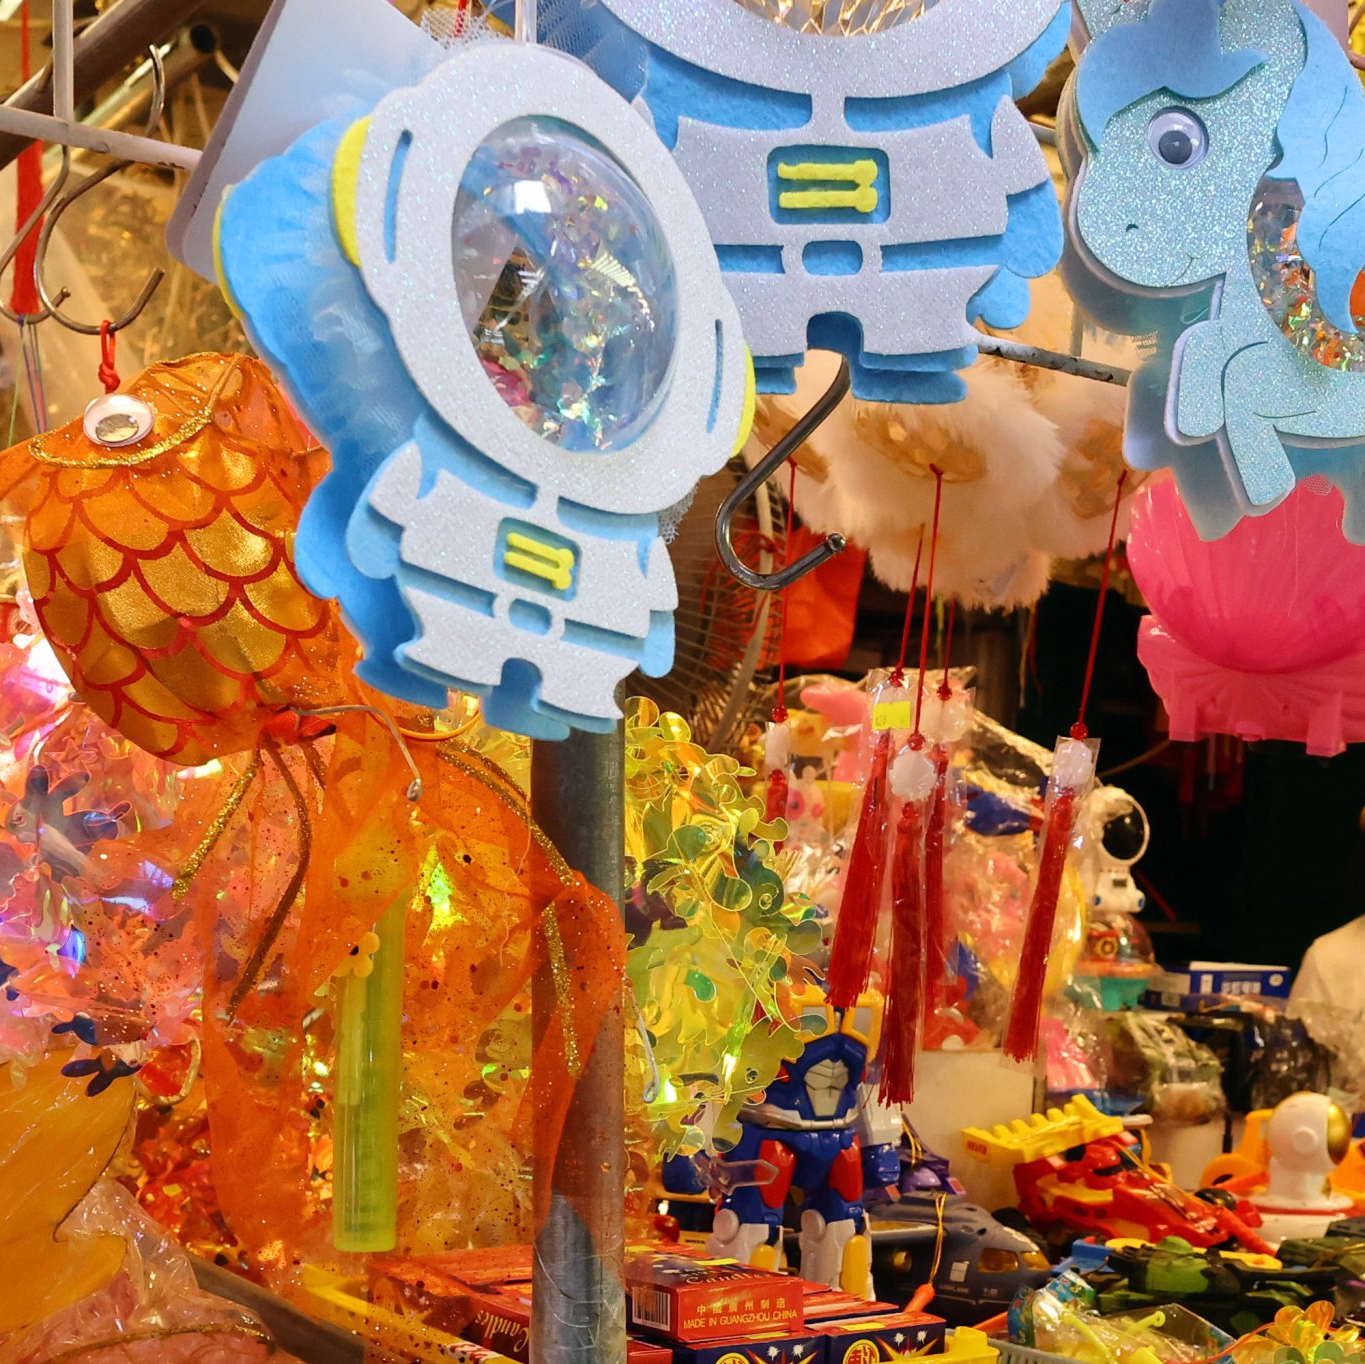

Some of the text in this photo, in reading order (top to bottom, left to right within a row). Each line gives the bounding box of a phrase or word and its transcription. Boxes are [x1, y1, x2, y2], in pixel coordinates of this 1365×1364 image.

[684, 1309, 797, 1329] MADE IN GUANGZHOU CHINA
